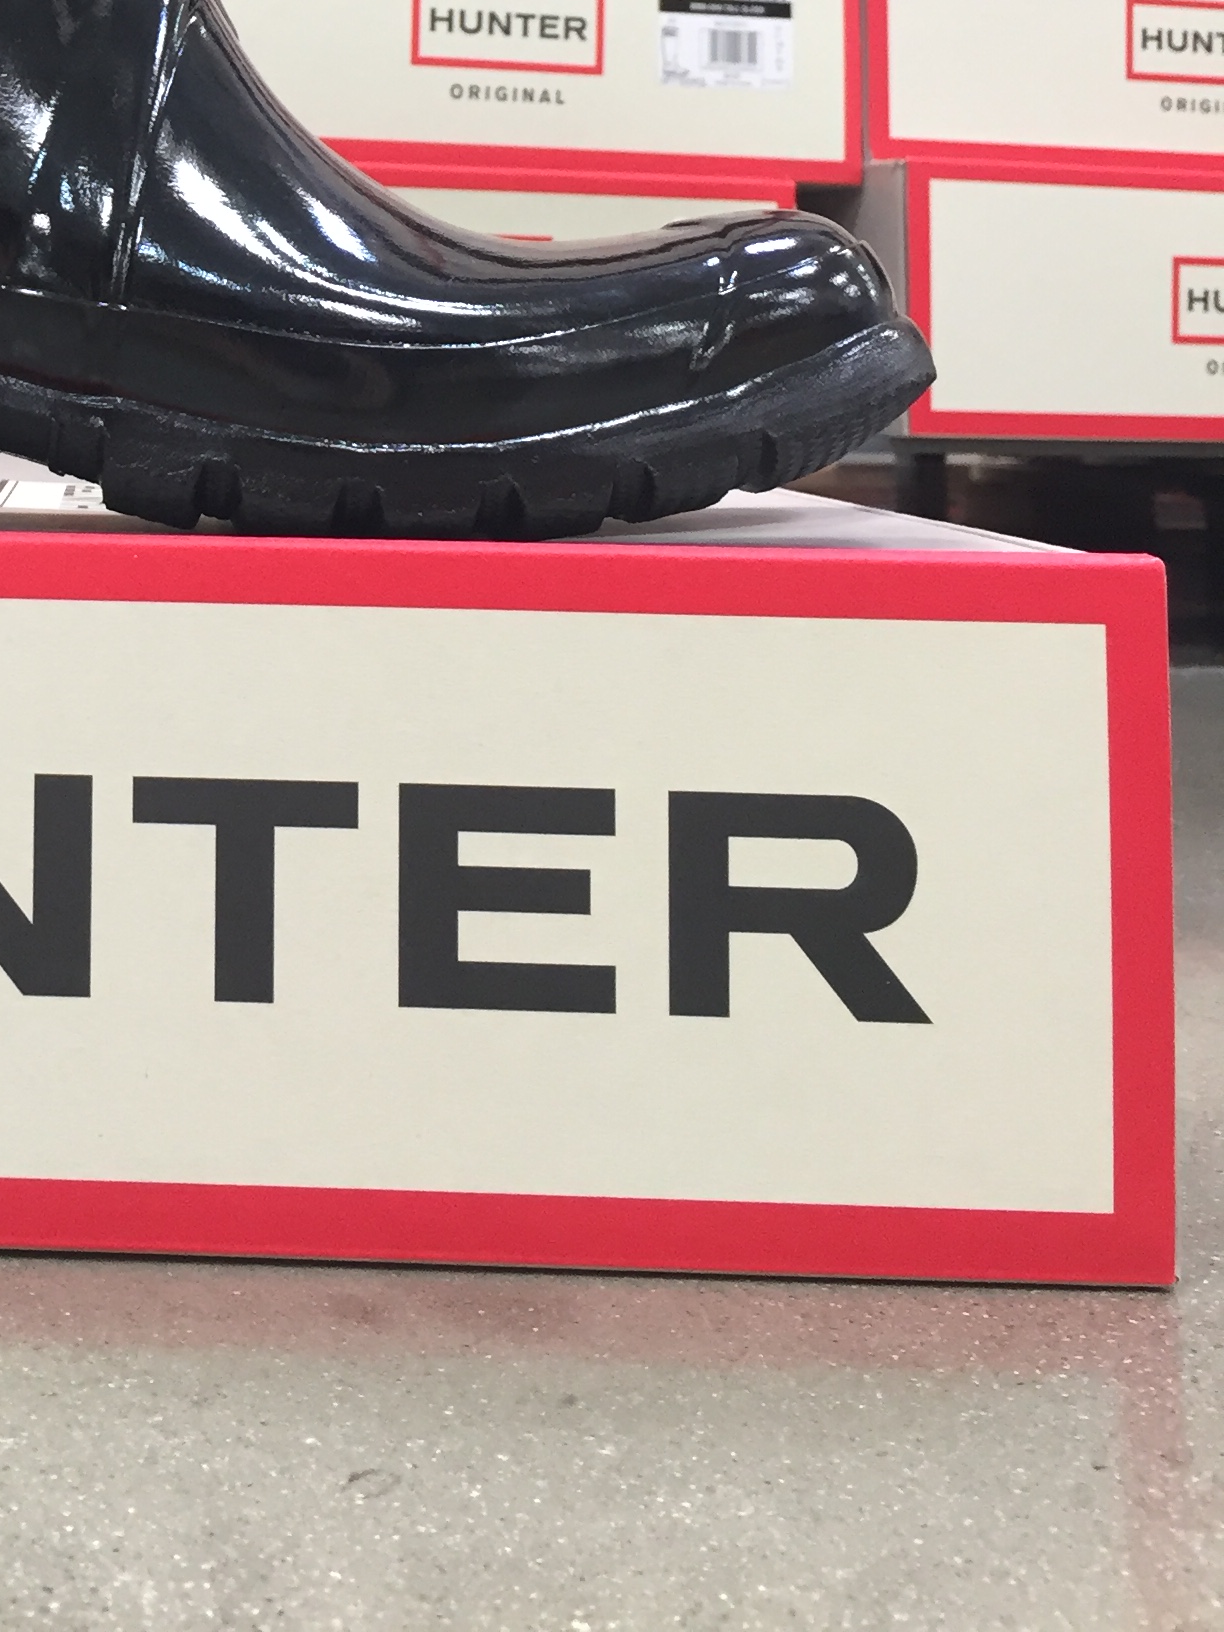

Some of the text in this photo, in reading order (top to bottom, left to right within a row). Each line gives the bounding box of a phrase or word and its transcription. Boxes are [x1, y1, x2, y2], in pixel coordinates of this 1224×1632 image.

[430, 8, 587, 41] HUNTER
[450, 84, 564, 105] ORIGINAL
[1161, 96, 1224, 114] ORIGI
